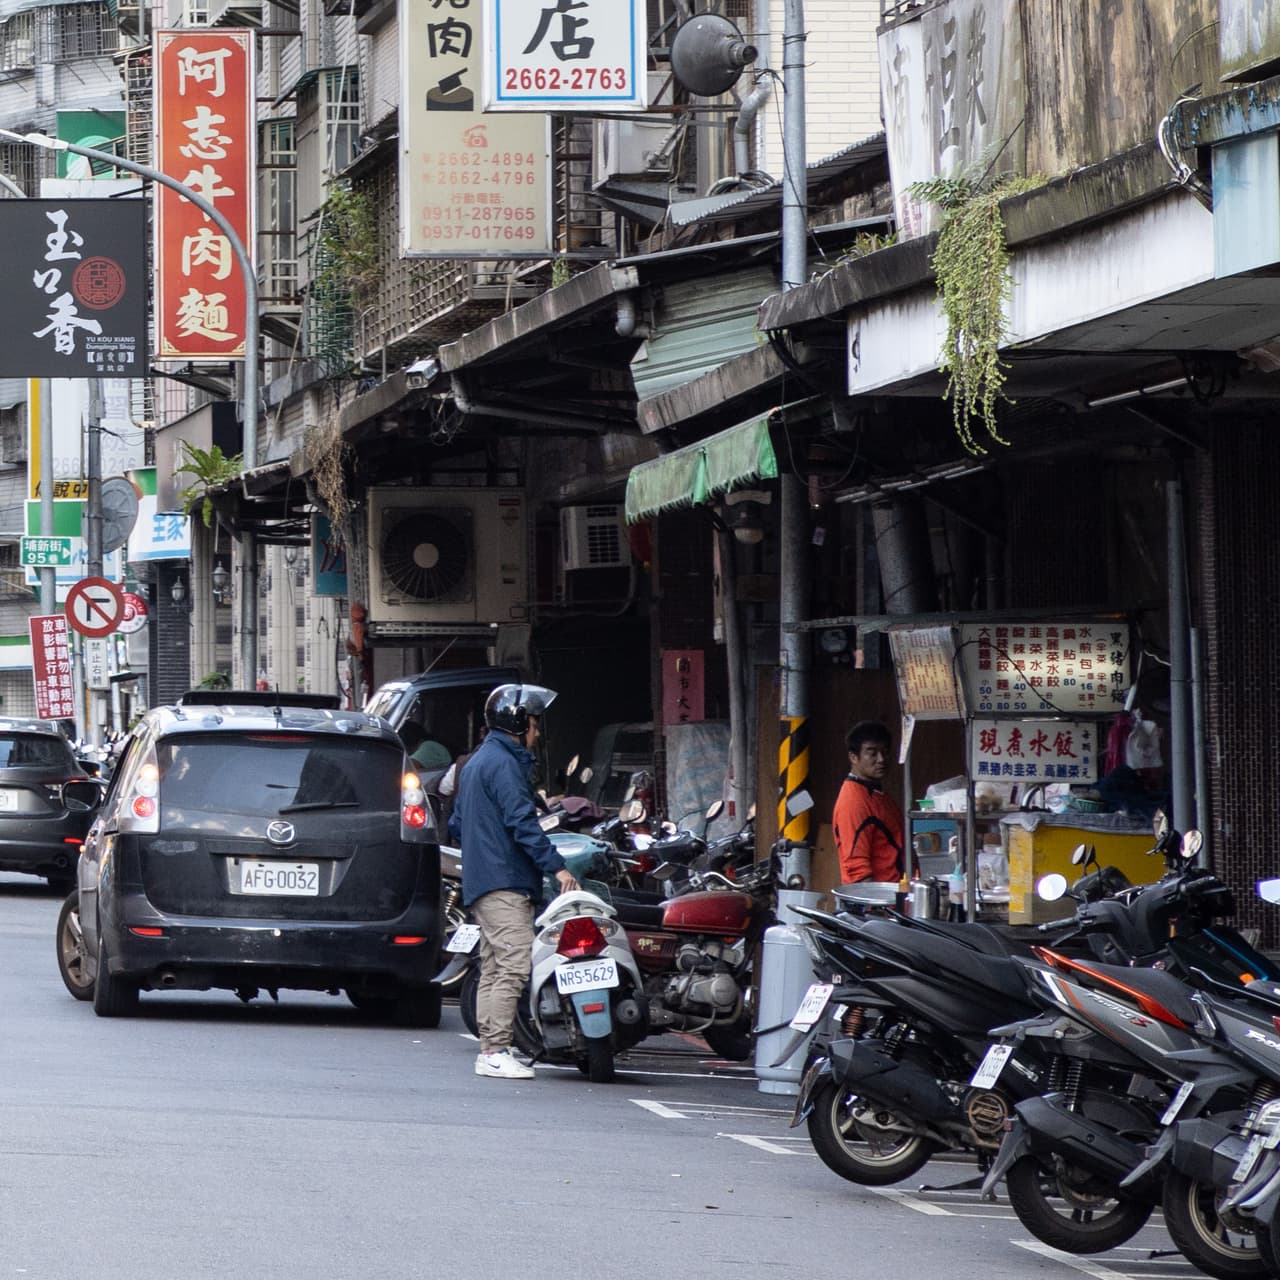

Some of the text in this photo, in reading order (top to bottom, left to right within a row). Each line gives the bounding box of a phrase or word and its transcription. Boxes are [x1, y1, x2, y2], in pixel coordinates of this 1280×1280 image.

[506, 68, 626, 90] 2662-2763
[176, 47, 237, 342] 阿志牛肉麵
[423, 225, 535, 239] 0937-017649
[33, 209, 103, 355] 玉口香
[1013, 682, 1026, 691] 40
[1063, 678, 1077, 687] 80
[1081, 682, 1093, 691] 16
[979, 686, 992, 695] 50
[997, 702, 1010, 710] 80
[1013, 702, 1027, 710] 50
[978, 727, 1079, 759] 現煮水餃
[243, 864, 317, 891] AFG-0032
[559, 966, 614, 988] NRS-5629
